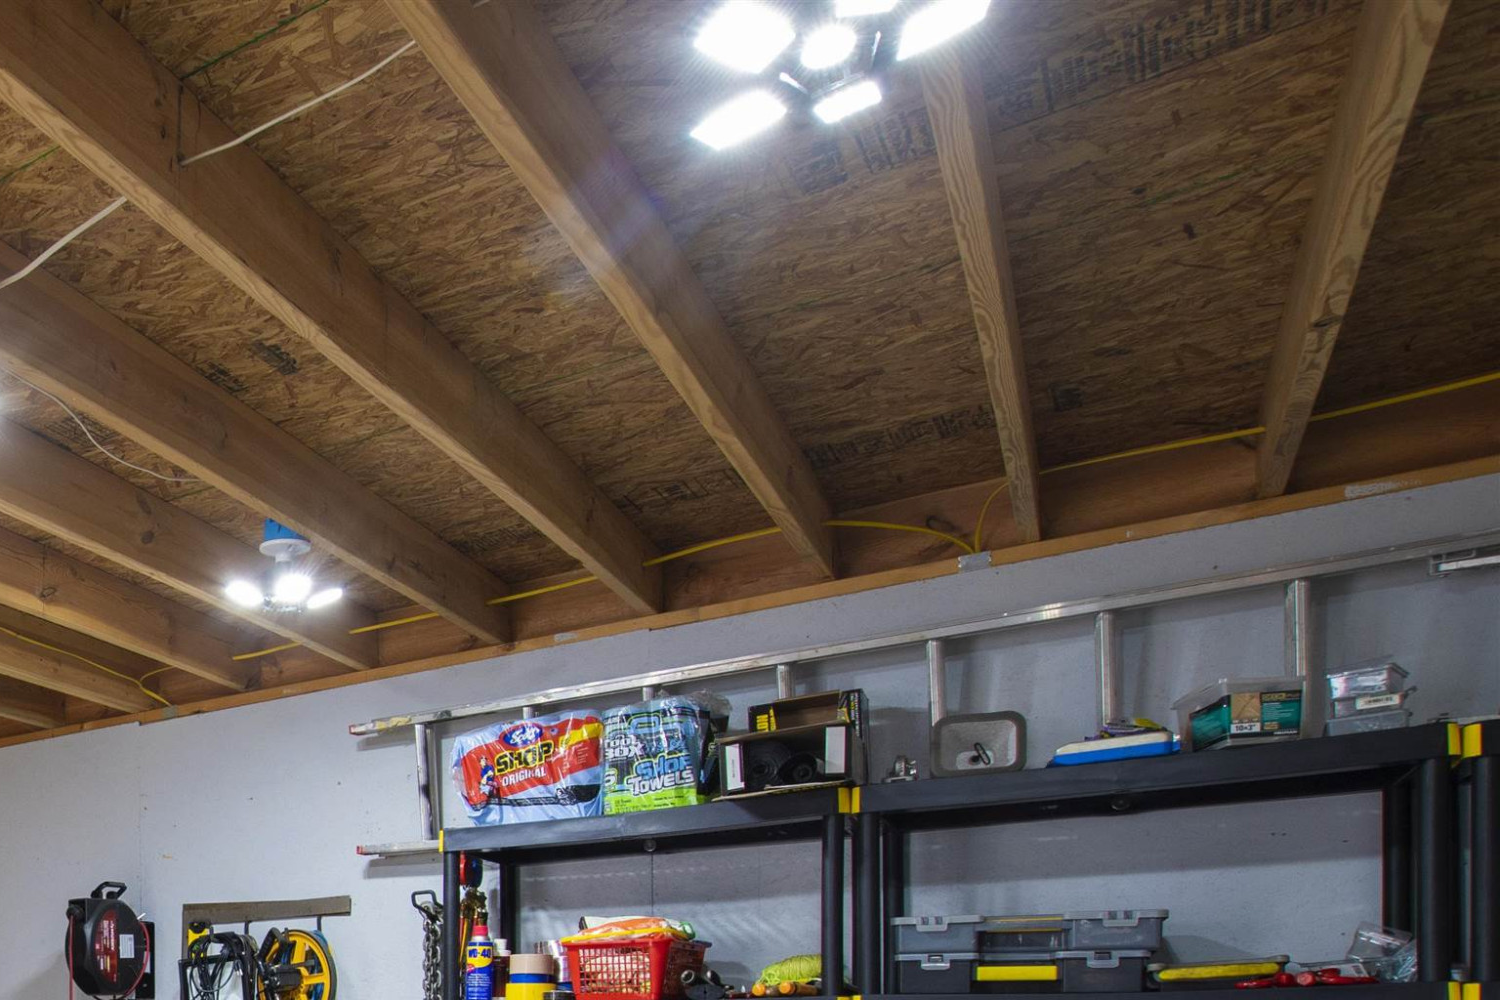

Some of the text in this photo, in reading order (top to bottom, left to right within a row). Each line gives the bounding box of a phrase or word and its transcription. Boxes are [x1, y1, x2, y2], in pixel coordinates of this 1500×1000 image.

[496, 743, 553, 773] SHOP
[502, 765, 547, 787] ORIGINAL
[626, 769, 695, 796] TOWELS
